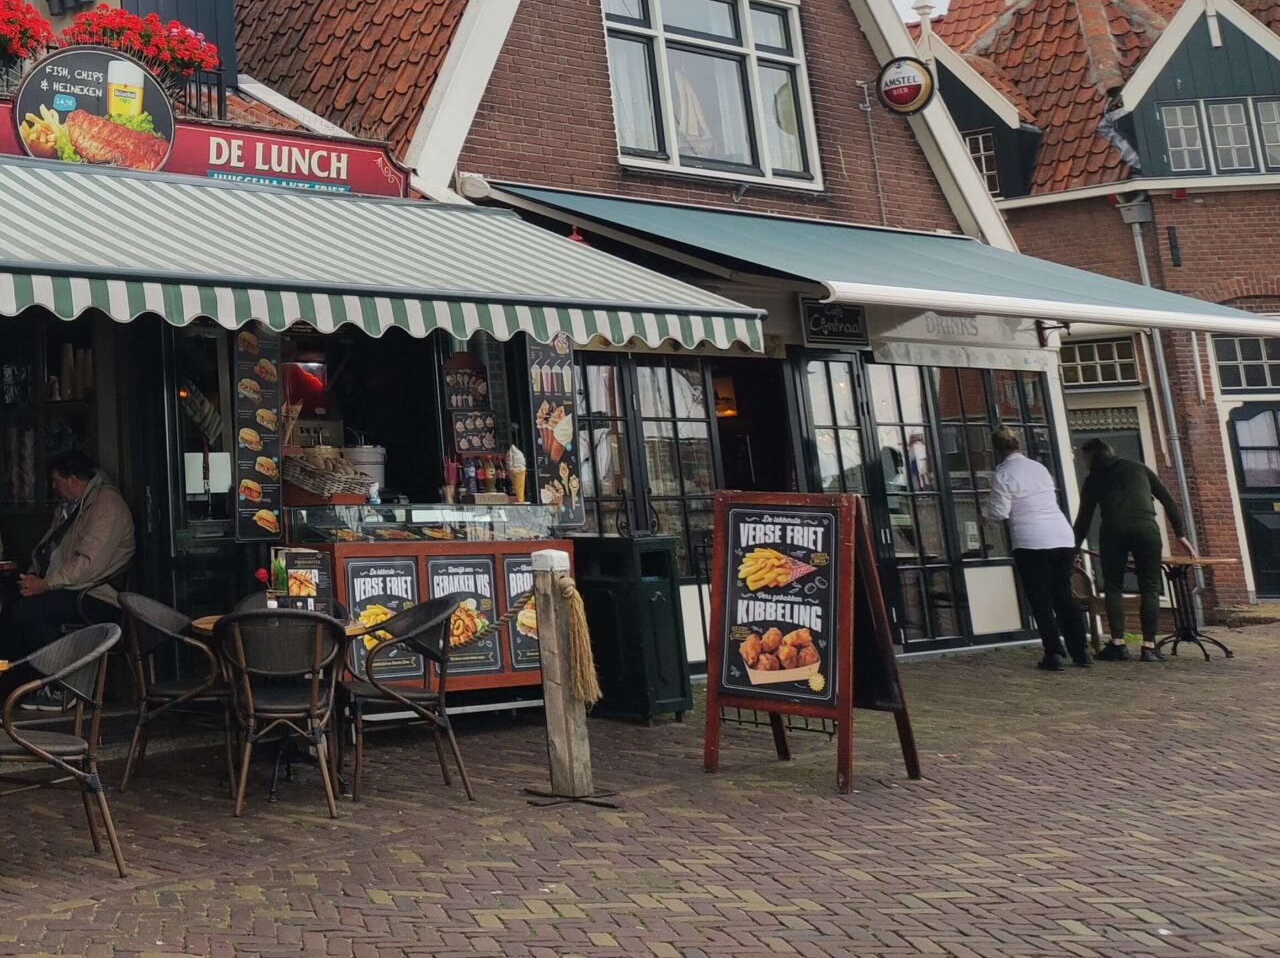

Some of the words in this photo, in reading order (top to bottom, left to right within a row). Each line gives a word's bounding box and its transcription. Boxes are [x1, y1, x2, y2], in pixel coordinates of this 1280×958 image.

[46, 65, 71, 79] FISH,
[74, 70, 103, 82] CHIPS
[884, 76, 920, 89] AMSTEL
[40, 78, 49, 91] &
[53, 82, 103, 97] HEINEKEN
[209, 136, 245, 168] DE
[255, 142, 348, 179] LUNCH
[810, 314, 862, 335] Centraal
[925, 315, 979, 337] DRINKS
[739, 523, 782, 548] VERSE
[786, 524, 825, 552] FRIET
[354, 577, 384, 602] VERSE
[386, 576, 412, 600] FRIET
[433, 574, 475, 599] GEBAKKEN
[475, 574, 491, 598] VIS
[737, 599, 822, 633] KIBBELING
